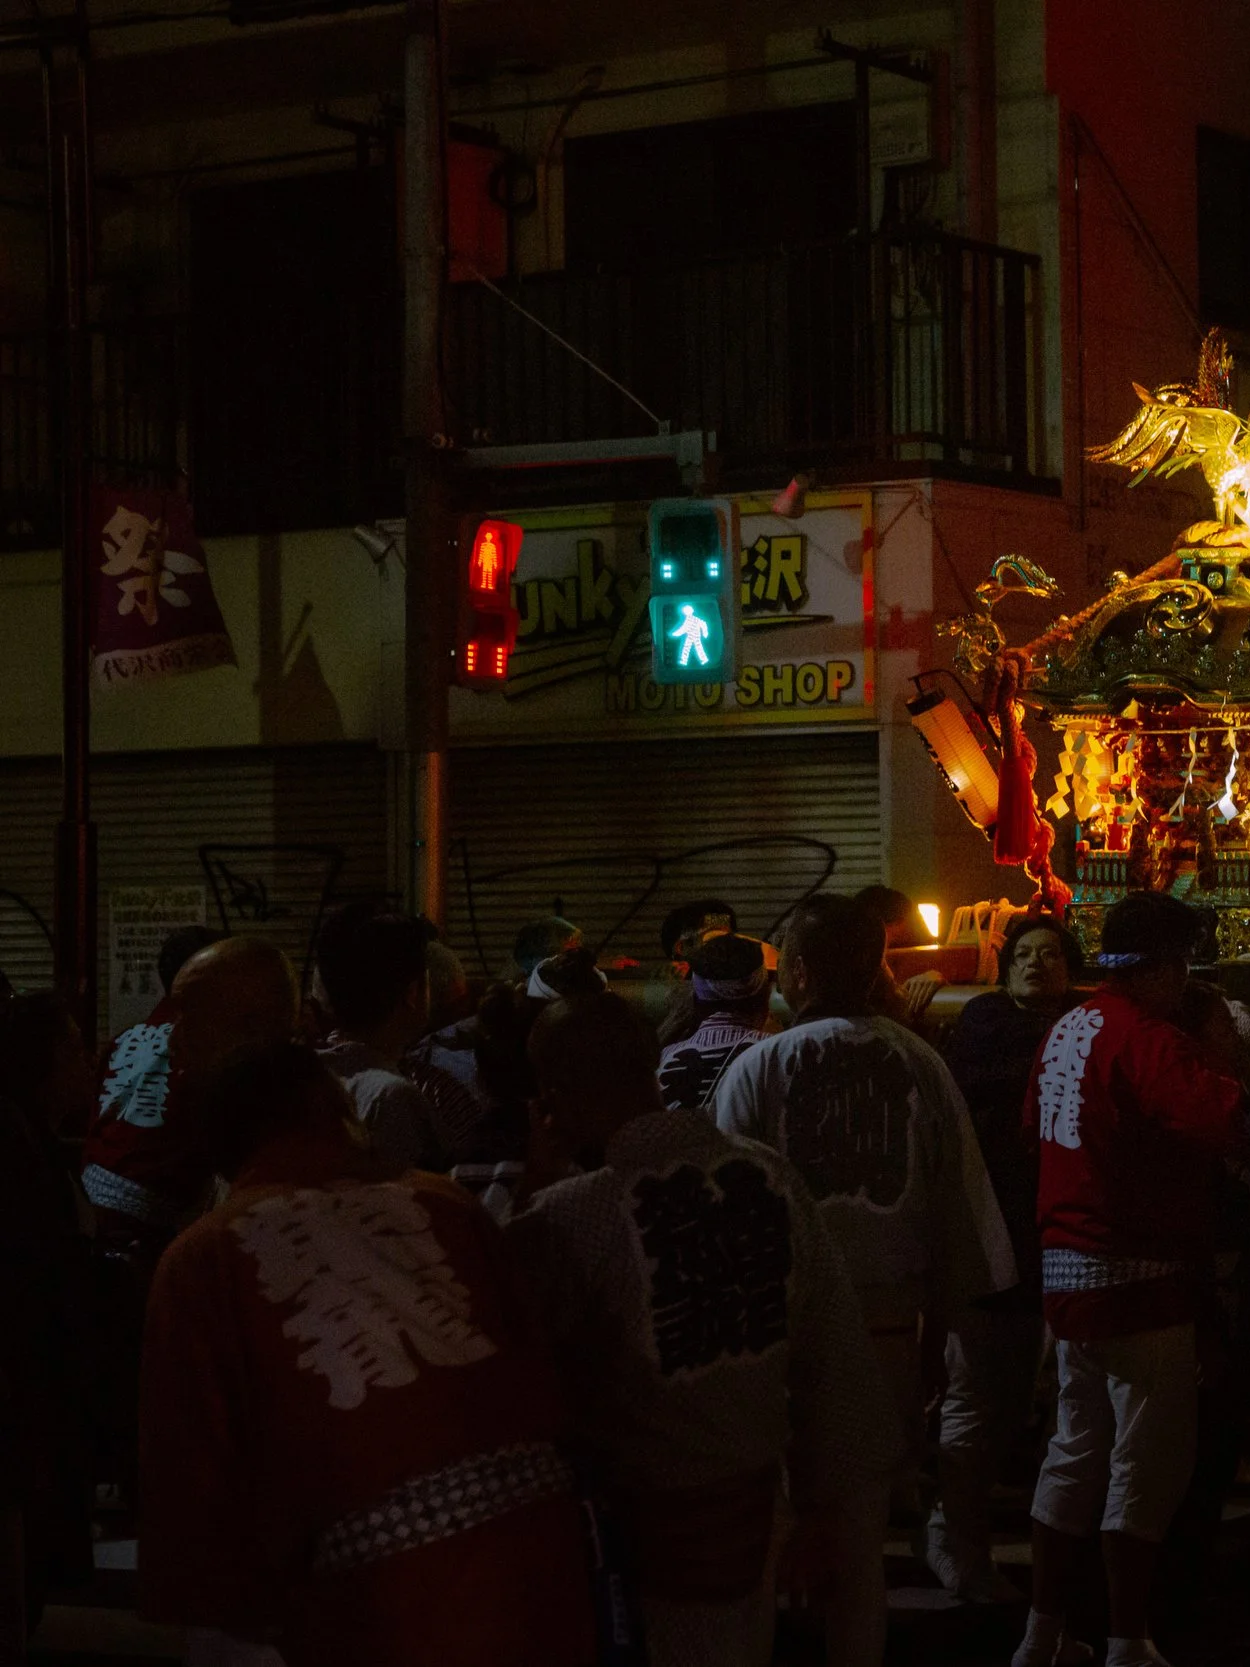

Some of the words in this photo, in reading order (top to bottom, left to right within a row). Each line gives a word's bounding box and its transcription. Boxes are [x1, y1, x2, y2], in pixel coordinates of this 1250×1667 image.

[100, 504, 205, 627] 祭
[605, 671, 724, 711] MOTO
[735, 660, 855, 706] SHOP
